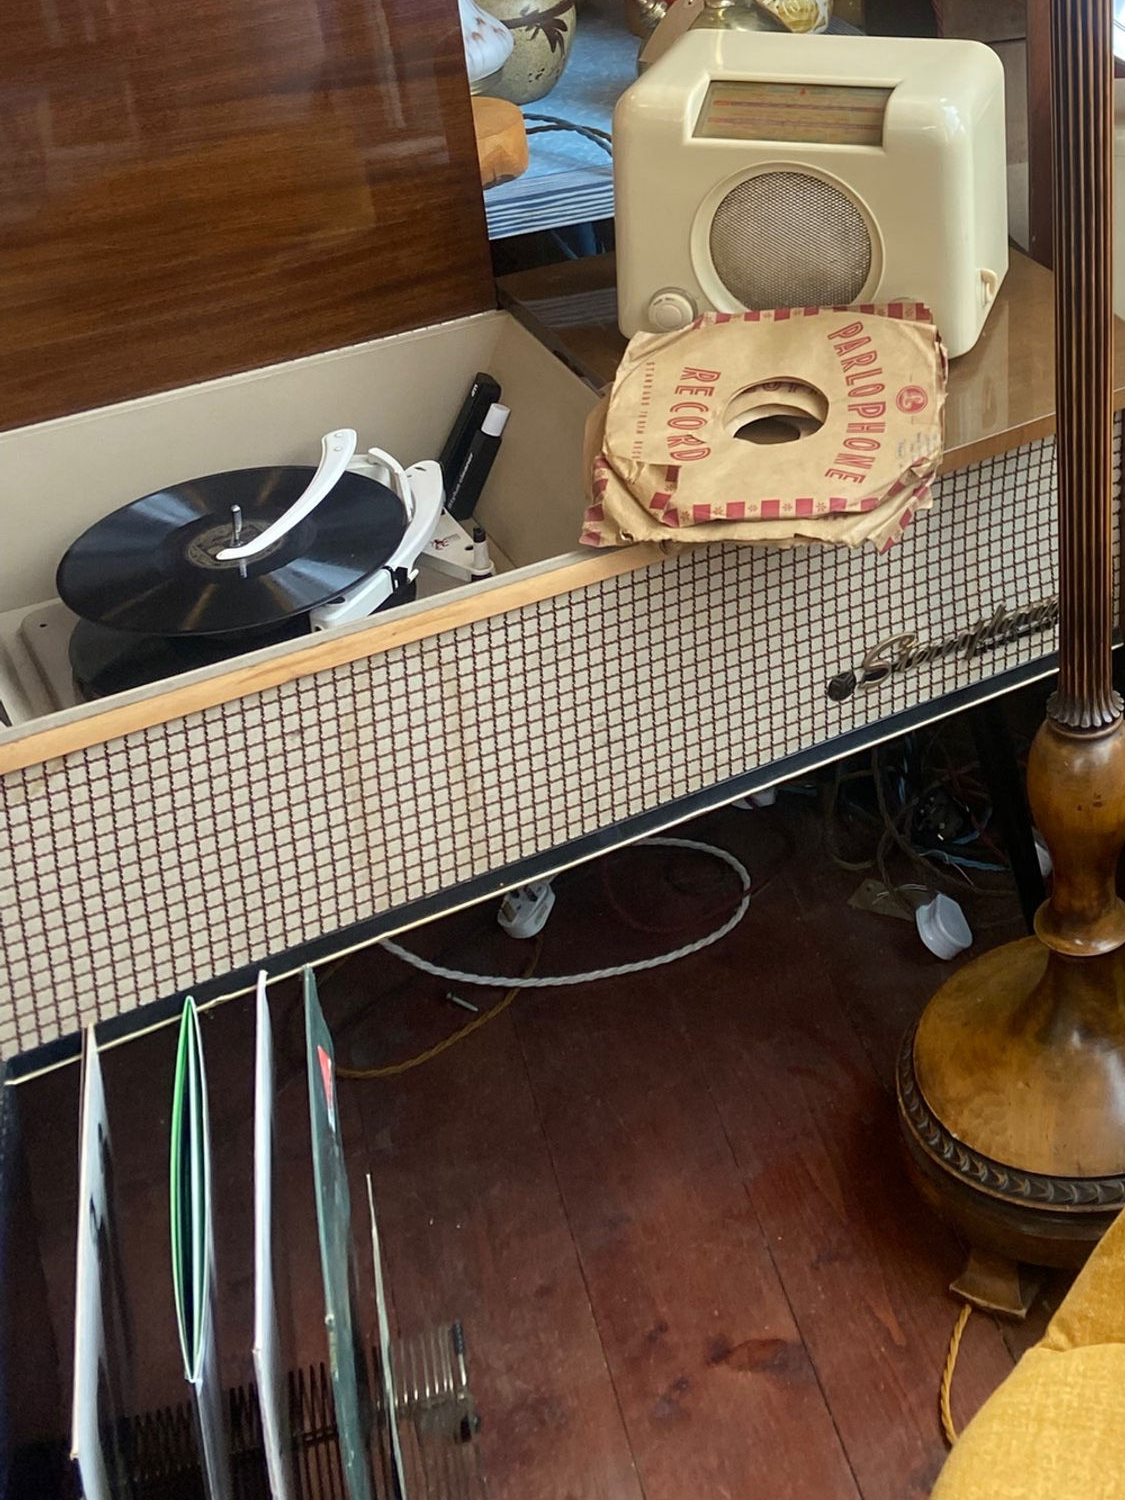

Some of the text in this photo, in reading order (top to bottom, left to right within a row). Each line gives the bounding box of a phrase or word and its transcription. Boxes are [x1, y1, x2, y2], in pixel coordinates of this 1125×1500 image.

[641, 362, 656, 406] STANDARD
[667, 366, 722, 462] RECORD
[826, 321, 886, 484] PARLOPHONE
[459, 452, 473, 484] cleaner
